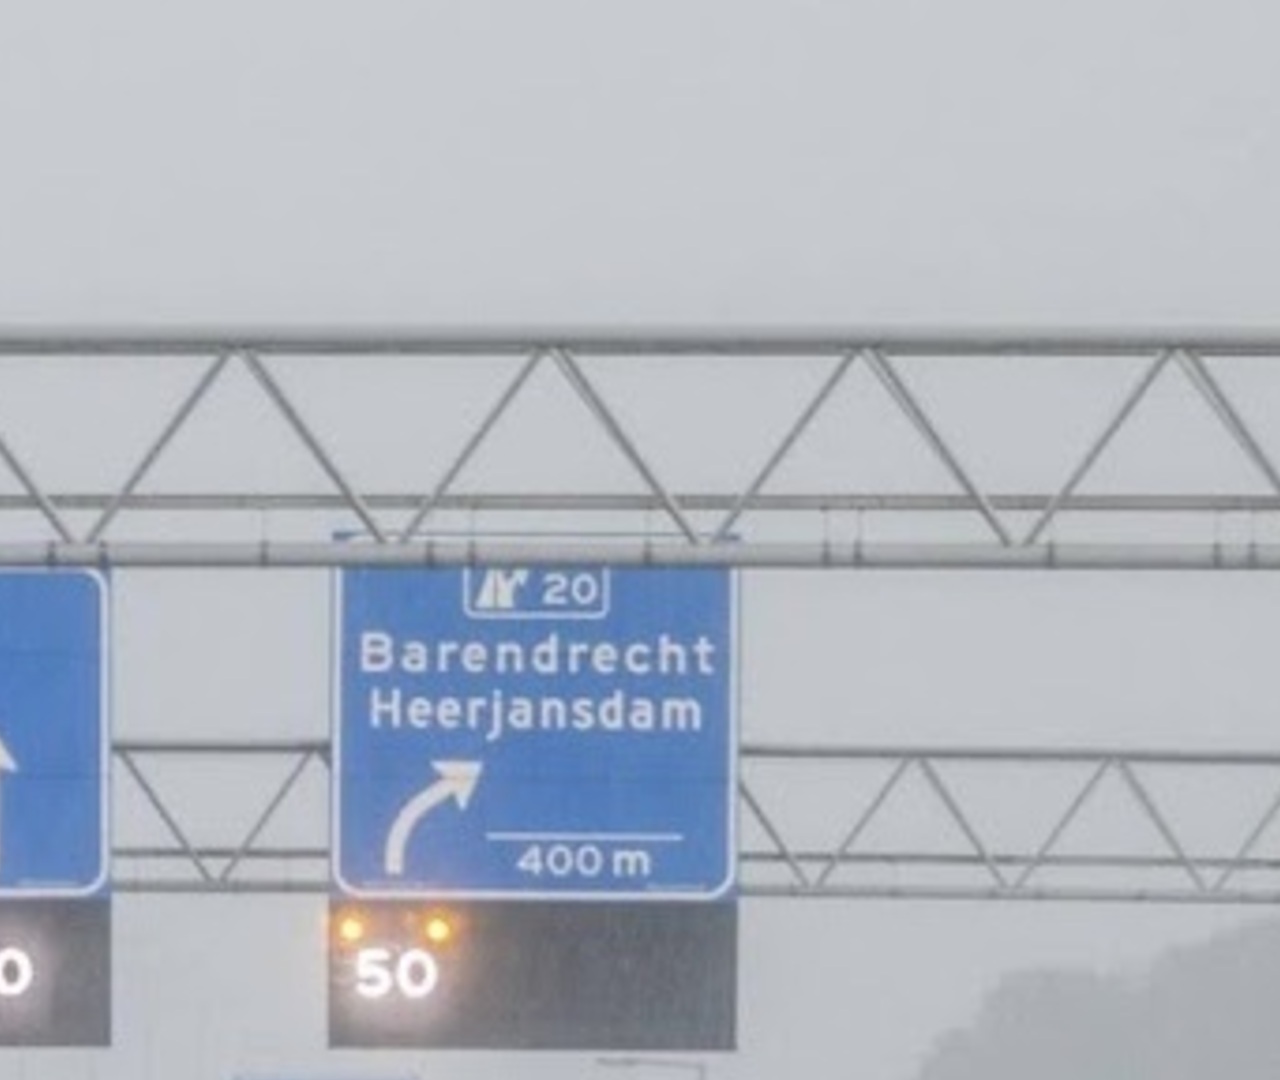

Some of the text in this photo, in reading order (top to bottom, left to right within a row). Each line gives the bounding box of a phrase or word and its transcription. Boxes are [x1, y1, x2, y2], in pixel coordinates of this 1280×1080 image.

[542, 572, 598, 606] 20
[360, 631, 716, 675] Barendrecht
[369, 689, 703, 740] Heerjansdam
[516, 845, 651, 877] 400 m
[354, 948, 439, 998] 50
